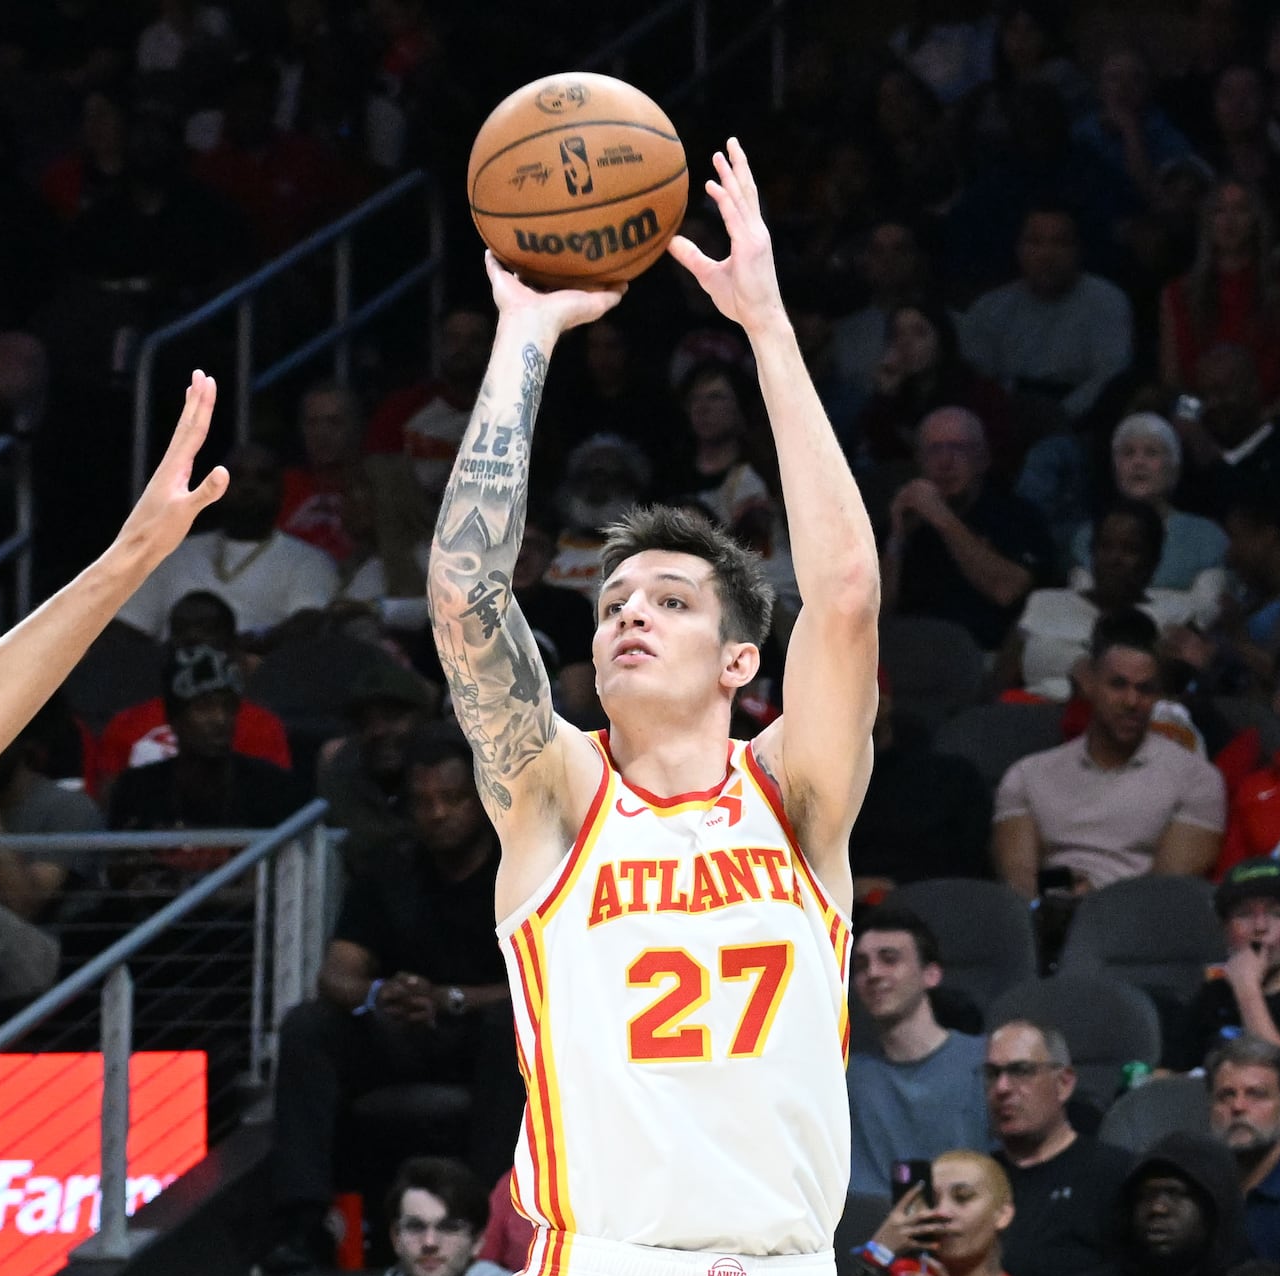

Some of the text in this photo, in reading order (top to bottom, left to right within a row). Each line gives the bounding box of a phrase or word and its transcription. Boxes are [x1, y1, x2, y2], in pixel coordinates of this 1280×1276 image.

[516, 208, 660, 261] Wilson
[472, 422, 513, 457] 27
[705, 815, 724, 827] the
[625, 940, 794, 1063] 27
